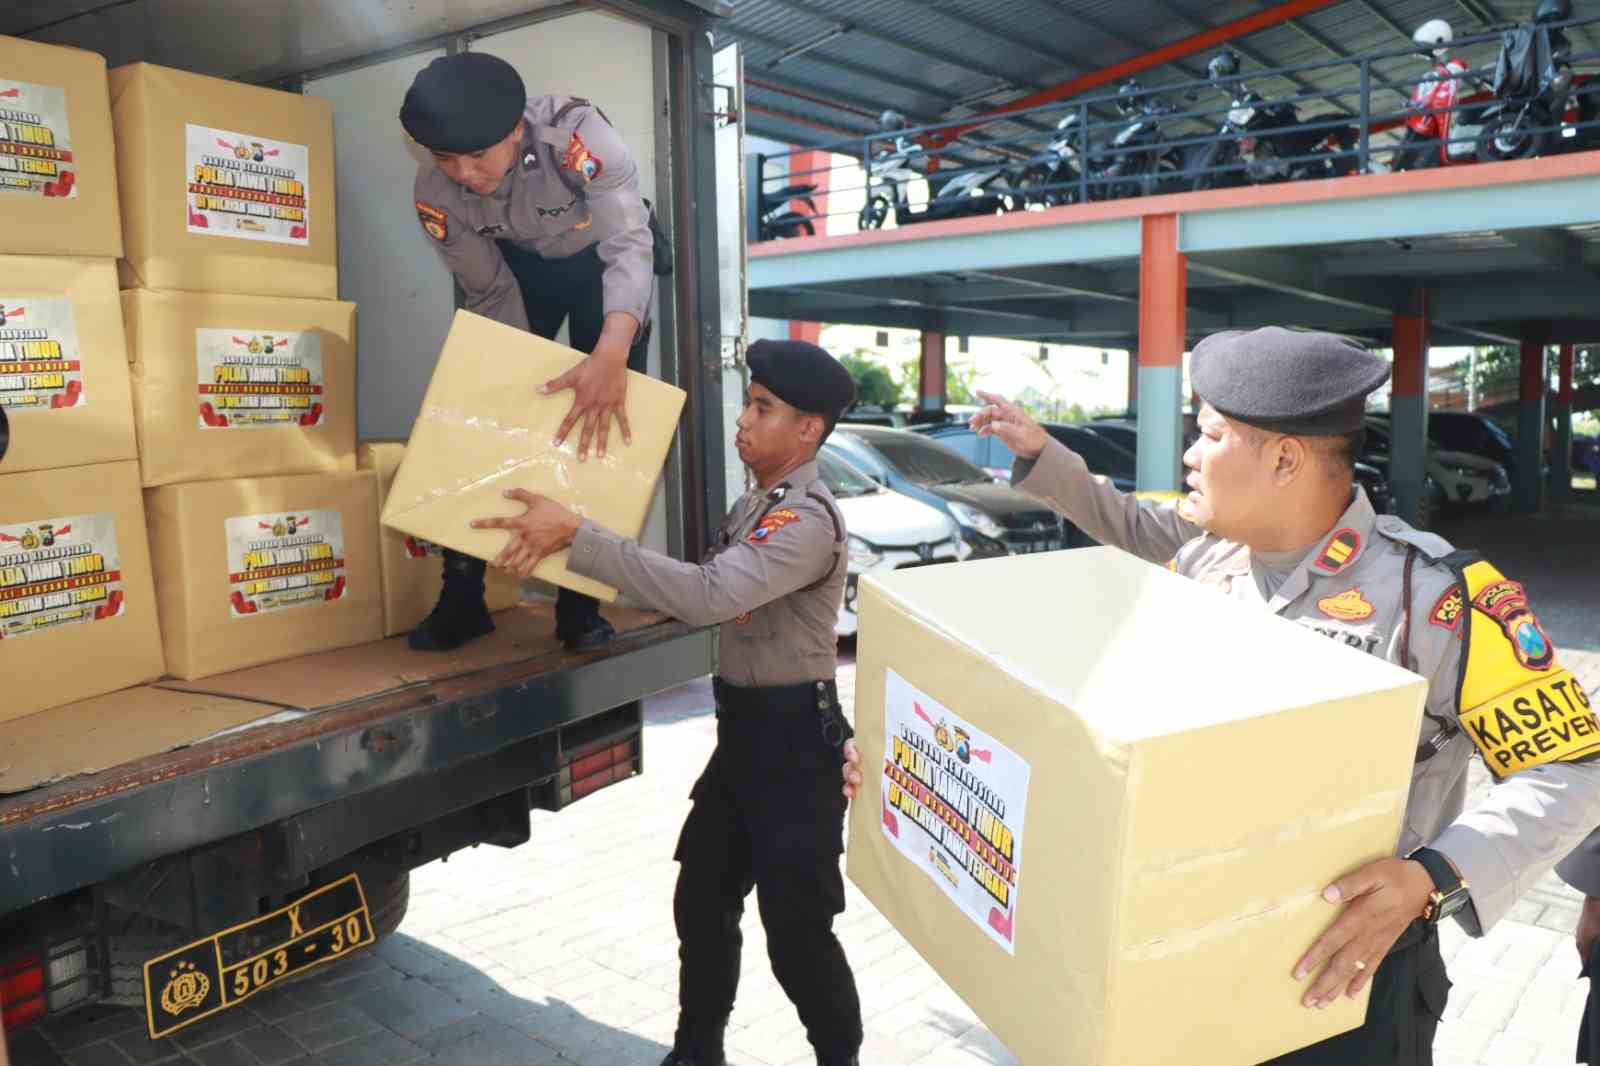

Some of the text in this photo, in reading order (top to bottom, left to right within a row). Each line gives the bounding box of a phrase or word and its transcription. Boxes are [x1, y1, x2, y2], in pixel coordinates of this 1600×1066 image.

[195, 164, 234, 186] POLDA
[236, 170, 266, 191] JAWA
[215, 365, 250, 383] POLDA
[250, 366, 279, 384] JAWA
[0, 553, 104, 588] LDA JAWA TIMUR
[243, 551, 277, 570] POLDA
[276, 547, 305, 565] JAWA
[893, 733, 1014, 863] POLDA JAWA TIMUR
[889, 780, 901, 811] DI
[900, 790, 942, 845] WILAYAH
[942, 826, 968, 870] JAWA
[968, 852, 1009, 909] TENGAH
[288, 904, 304, 938] X
[233, 950, 288, 996] 503
[331, 915, 360, 952] 30
